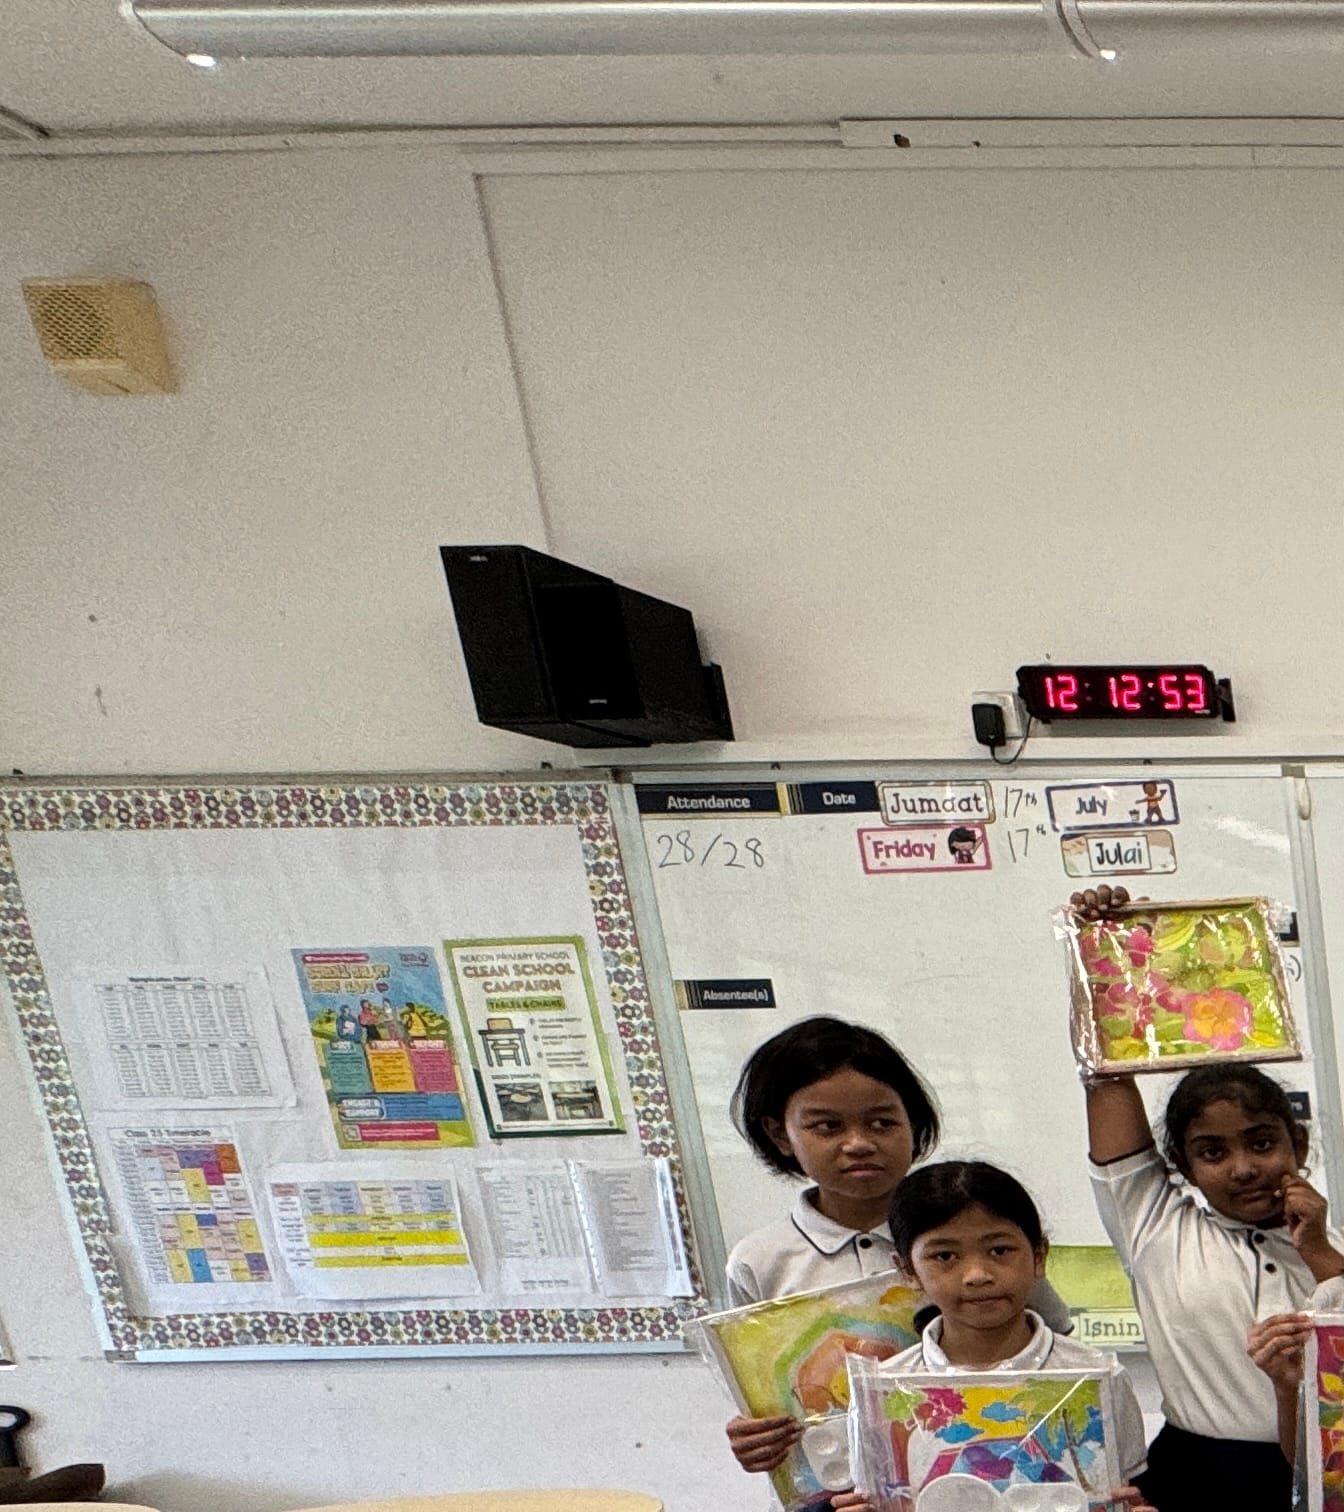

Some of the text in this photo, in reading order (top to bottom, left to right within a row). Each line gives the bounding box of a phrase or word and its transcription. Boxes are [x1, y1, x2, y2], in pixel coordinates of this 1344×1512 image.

[667, 795, 751, 810] Attendance
[822, 791, 856, 806] Date
[890, 793, 984, 814] Jumaat
[1075, 797, 1108, 816] July
[657, 830, 765, 869] 28/28
[873, 840, 936, 860] Friday
[1095, 843, 1143, 866] Julai
[535, 951, 571, 961] SCHOOL
[463, 962, 576, 978] CLEAN SCHOOL
[482, 979, 562, 994] CAMPAIGN
[703, 988, 769, 1002] Absentee(s)
[1083, 1317, 1141, 1338] Isnin
